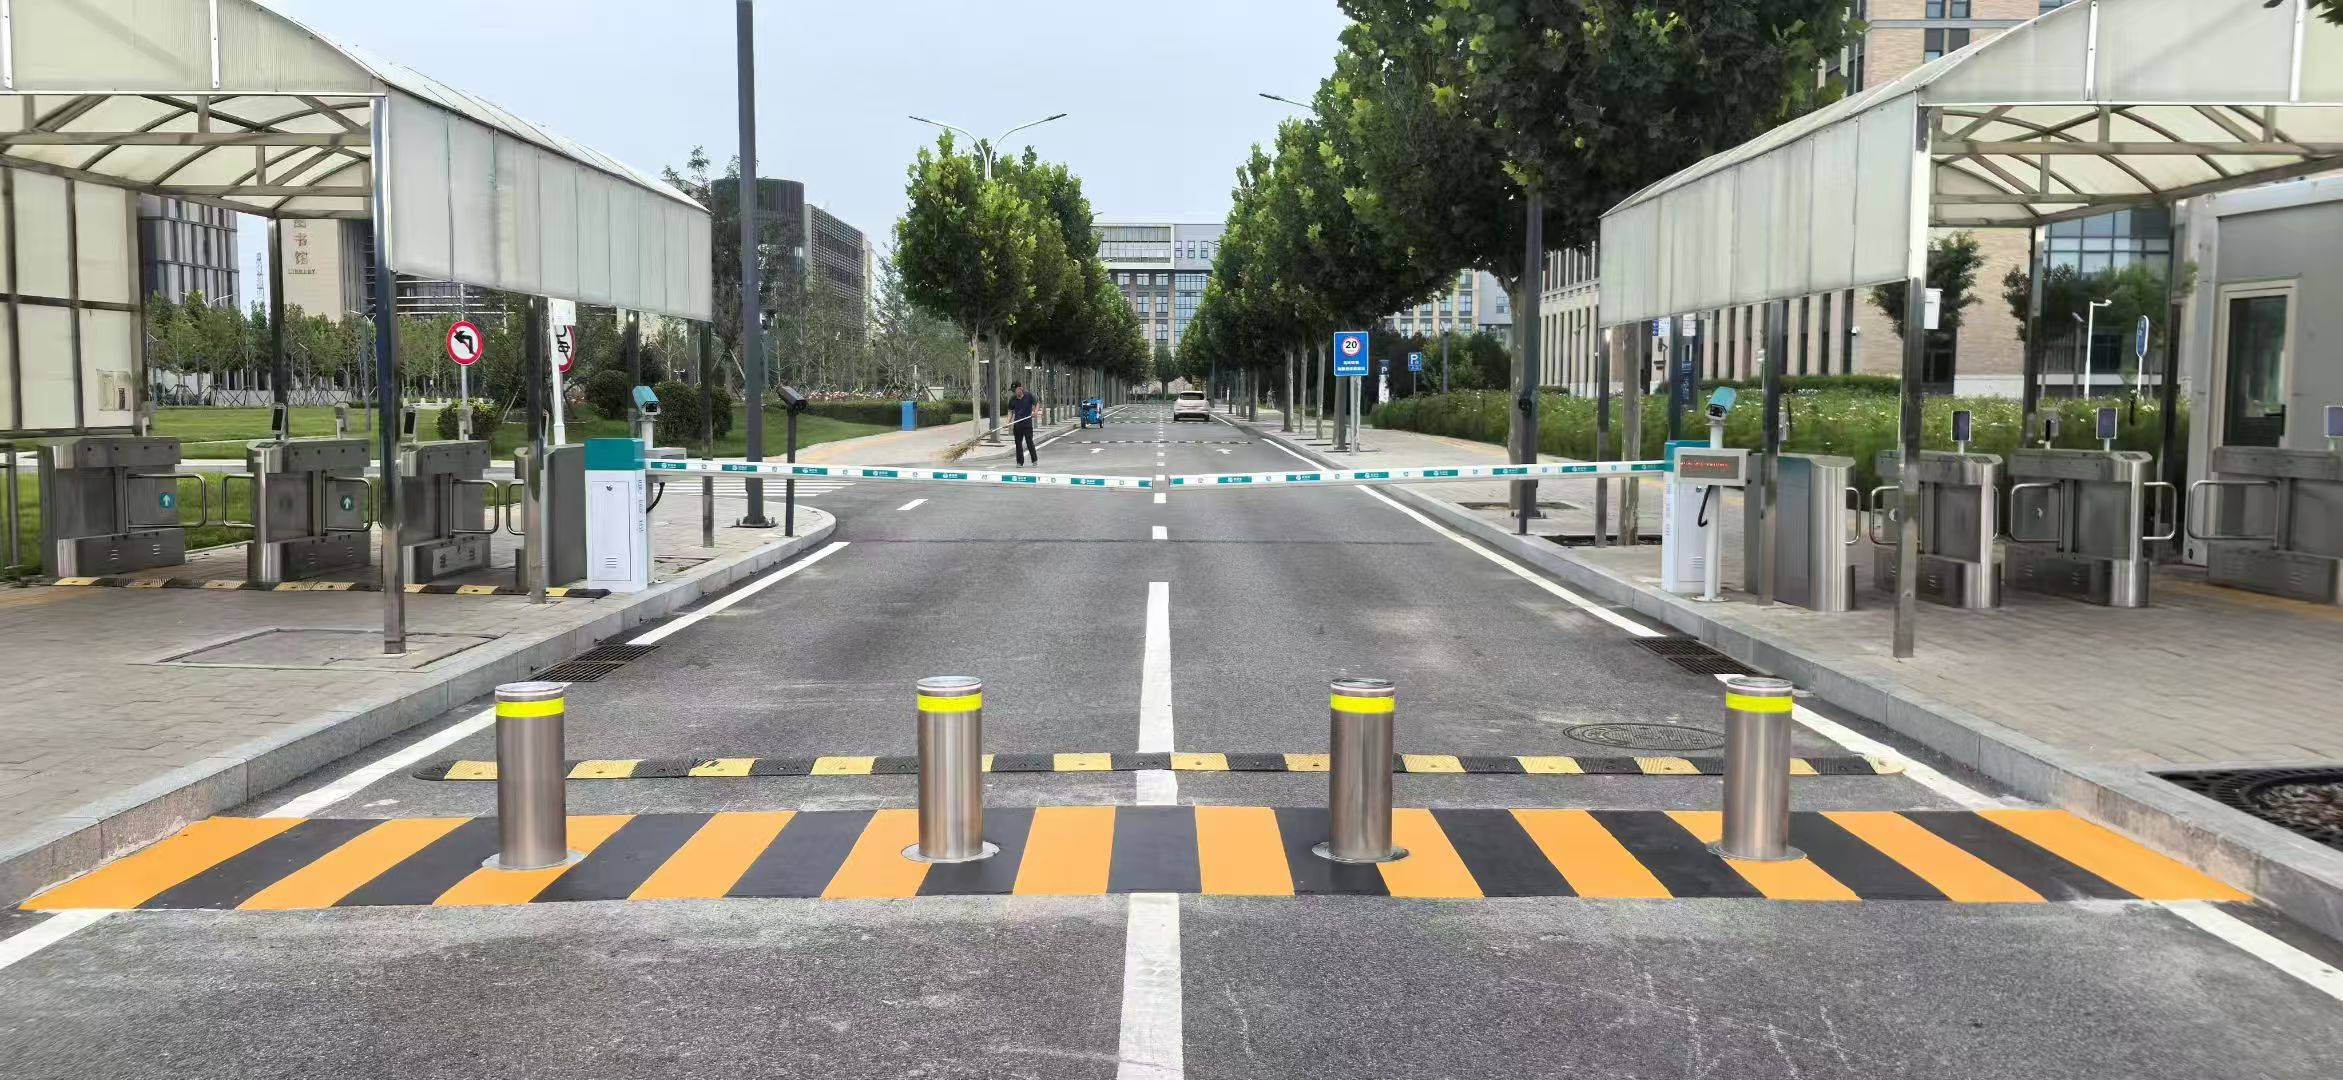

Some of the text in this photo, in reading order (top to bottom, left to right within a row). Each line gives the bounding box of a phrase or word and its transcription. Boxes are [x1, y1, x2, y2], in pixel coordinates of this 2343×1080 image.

[1345, 340, 1358, 349] 20
[1410, 354, 1418, 365] P
[1381, 366, 1388, 374] P
